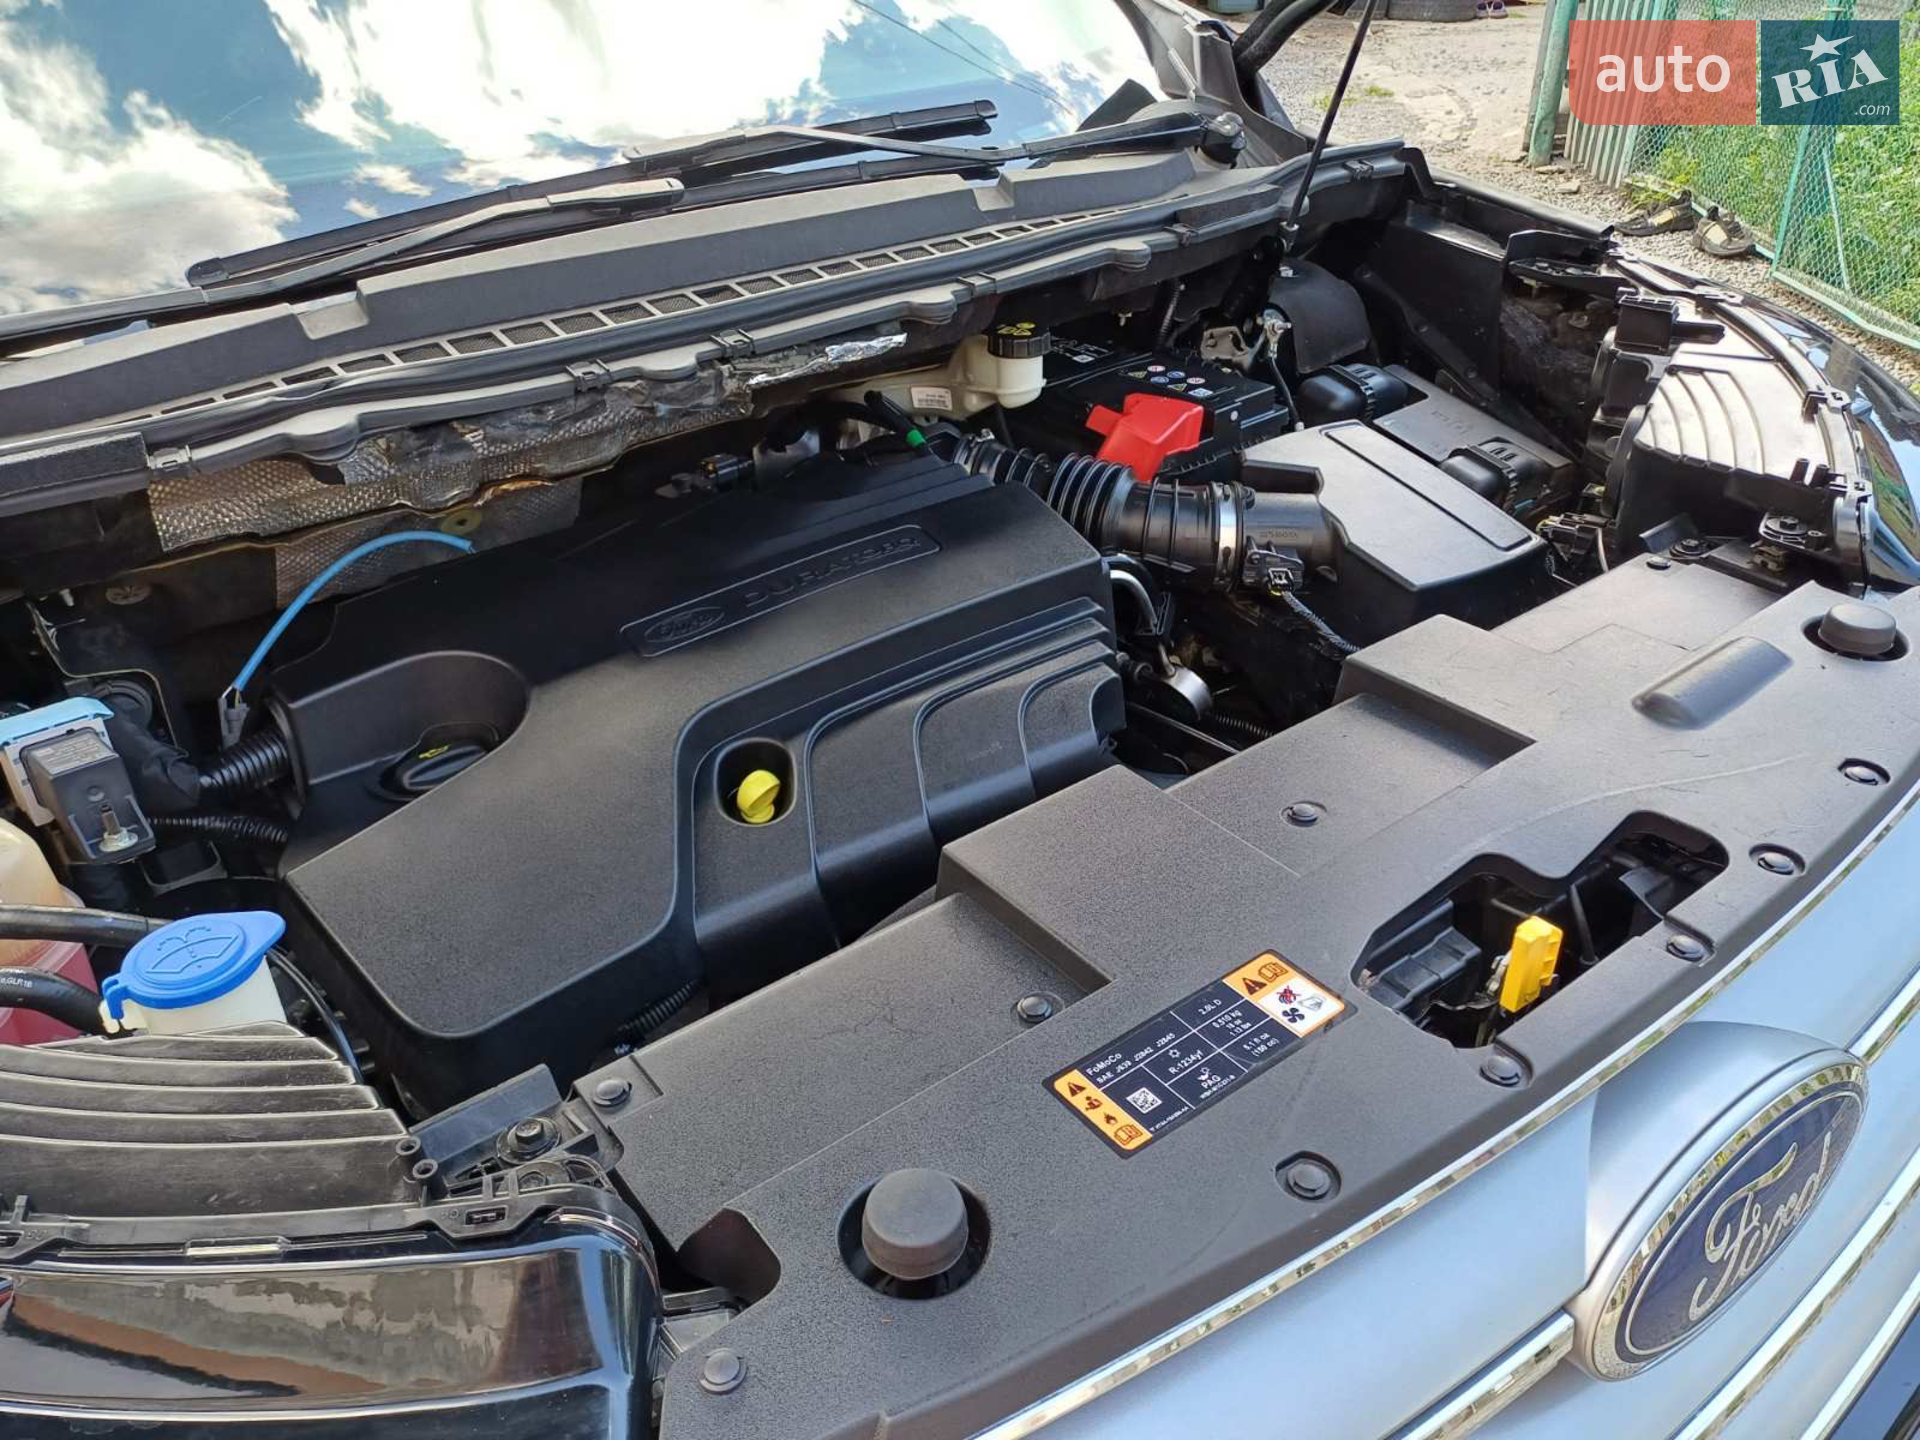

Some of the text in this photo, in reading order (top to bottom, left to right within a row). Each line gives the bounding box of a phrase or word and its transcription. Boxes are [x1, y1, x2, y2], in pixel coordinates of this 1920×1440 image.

[1214, 999, 1222, 1007] D
[1085, 1052, 1122, 1076] FoMoCo
[1168, 1049, 1204, 1075] R-1234yf
[1096, 1071, 1114, 1083] SAE
[1200, 1074, 1221, 1089] PAG
[1689, 1131, 1832, 1321] Ford
